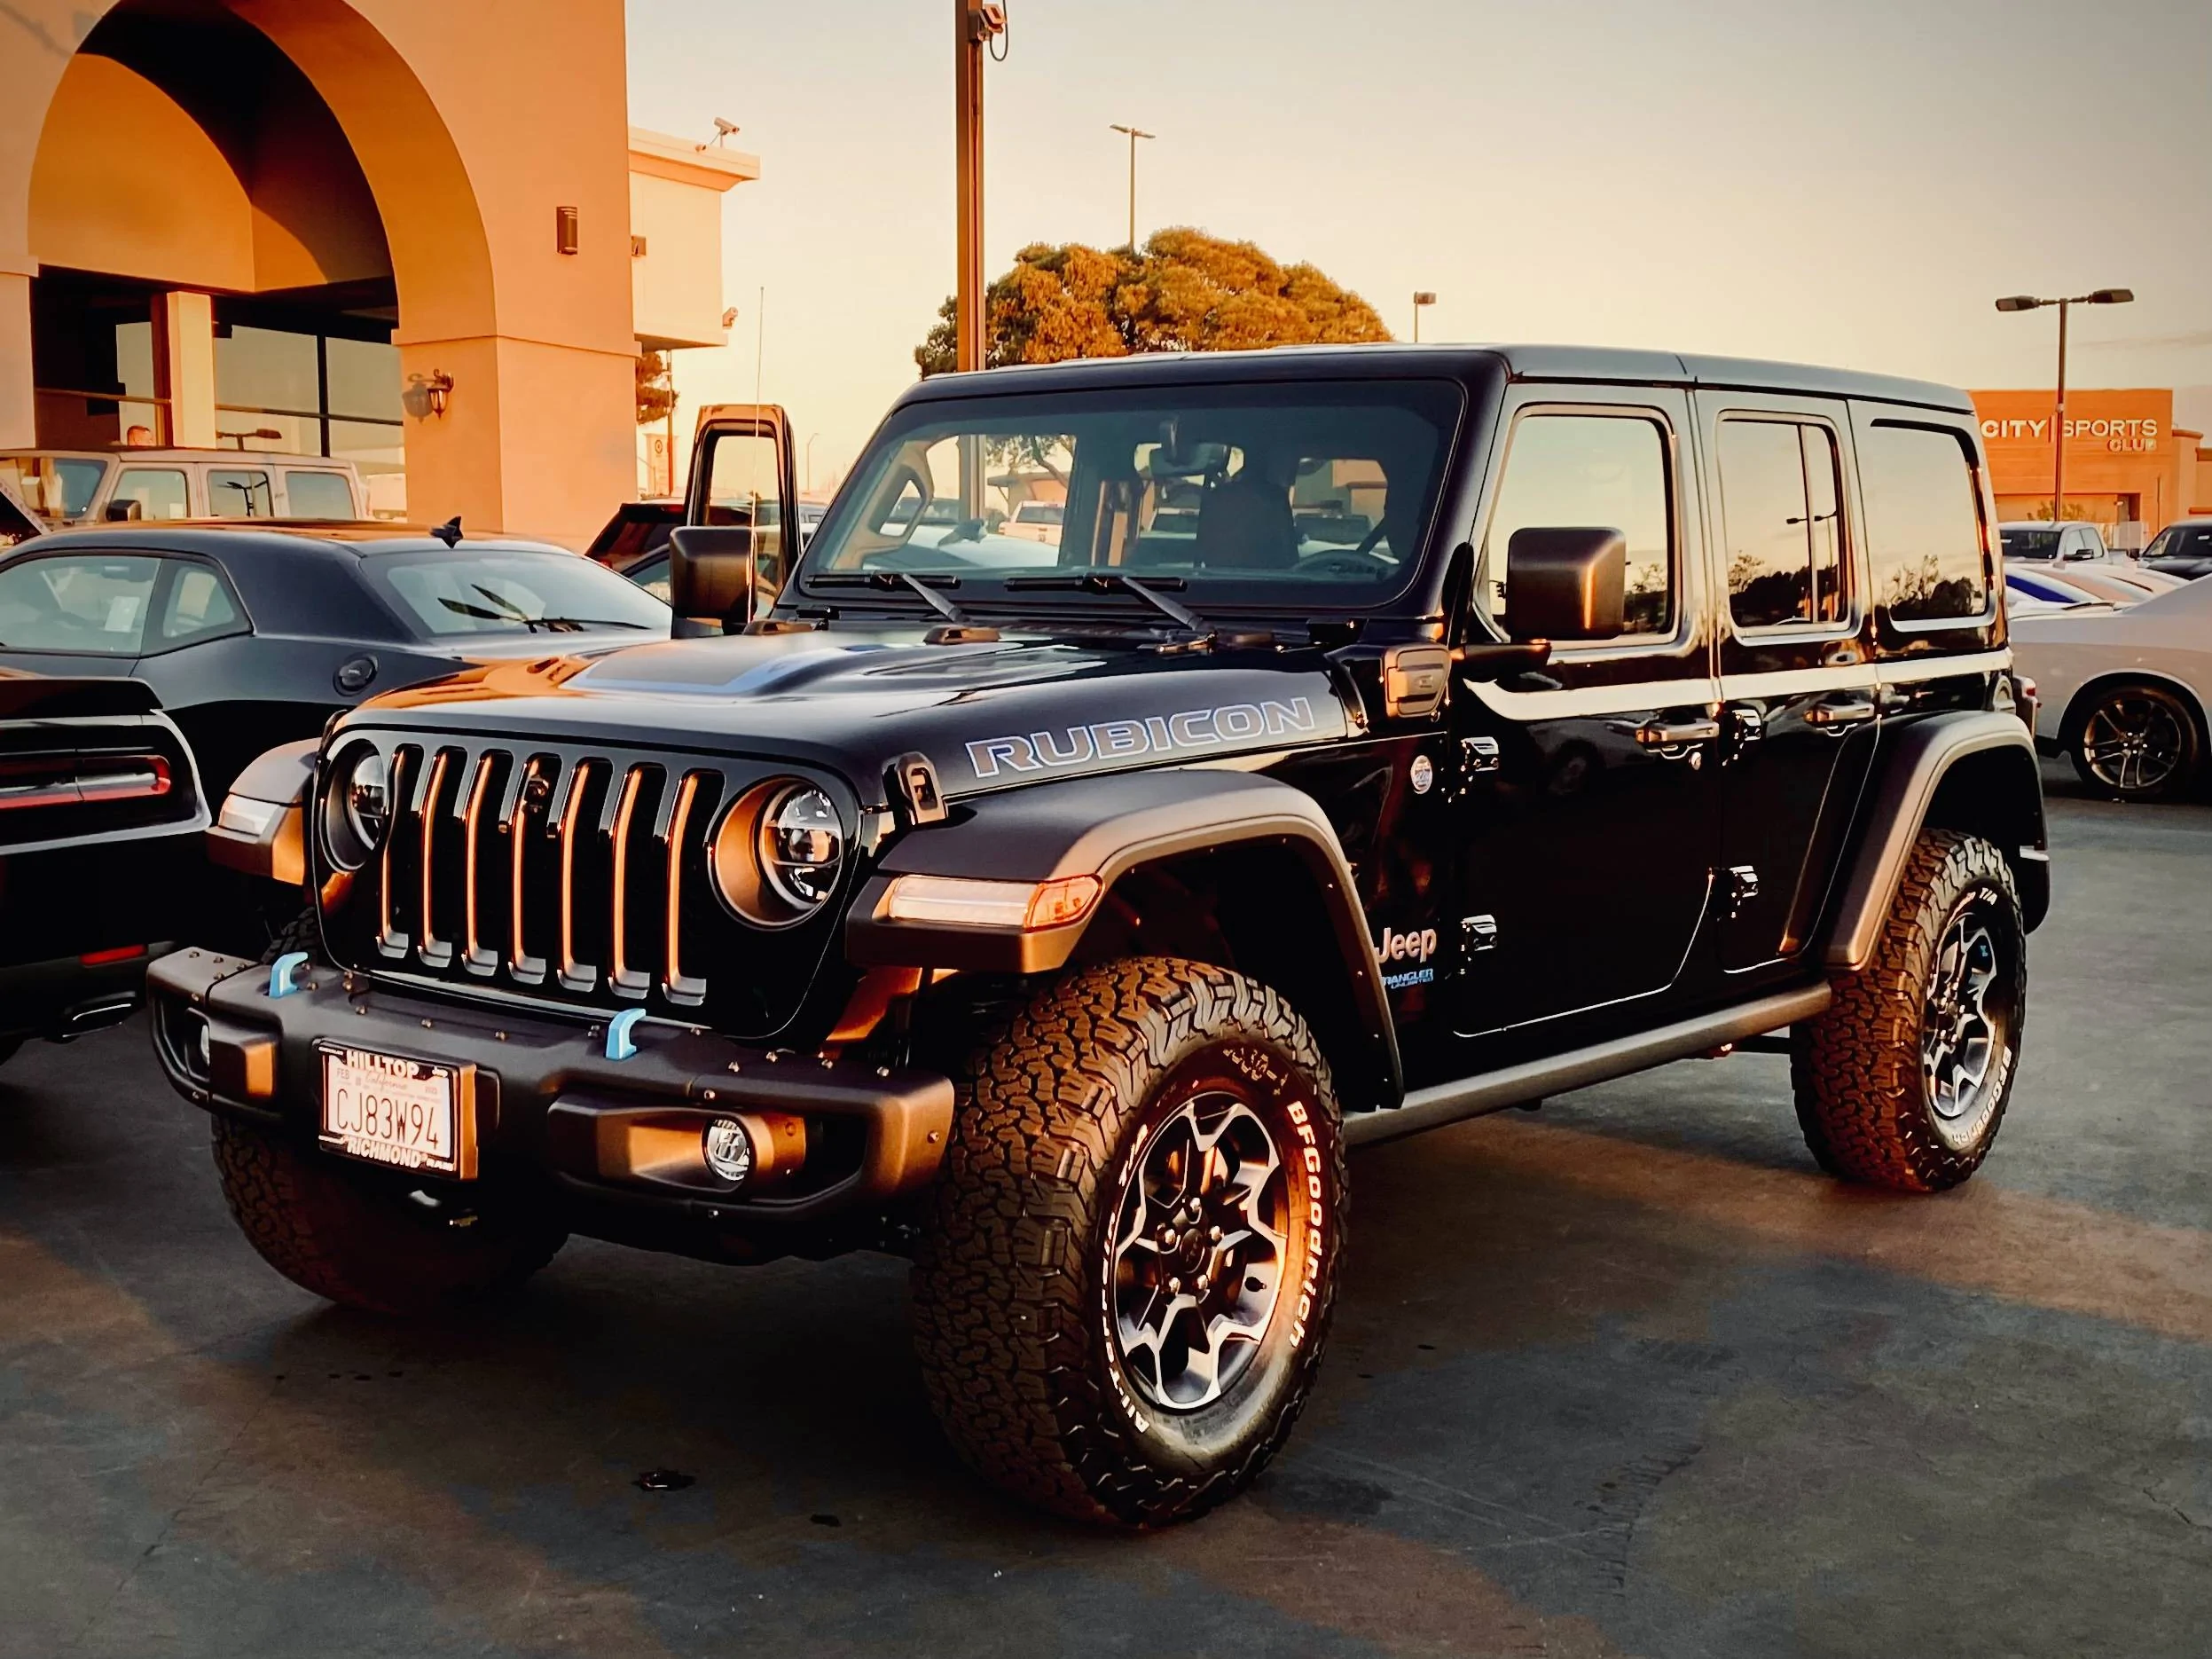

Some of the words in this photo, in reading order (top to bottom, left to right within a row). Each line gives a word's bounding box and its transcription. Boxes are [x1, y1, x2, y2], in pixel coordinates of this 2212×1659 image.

[1981, 420, 2047, 438] CITY
[2062, 419, 2158, 437] SPORTS
[2108, 439, 2157, 452] CLUB
[965, 696, 1314, 779] RUBICON
[1373, 927, 1437, 963] Jeep
[1381, 968, 1434, 986] RANGLER
[336, 1067, 349, 1080] FEB
[346, 1050, 420, 1080] HILLTOP
[337, 1089, 438, 1150] CJ83W94
[347, 1136, 420, 1168] RICHMOND
[1286, 1100, 1322, 1348] BFGoodrich
